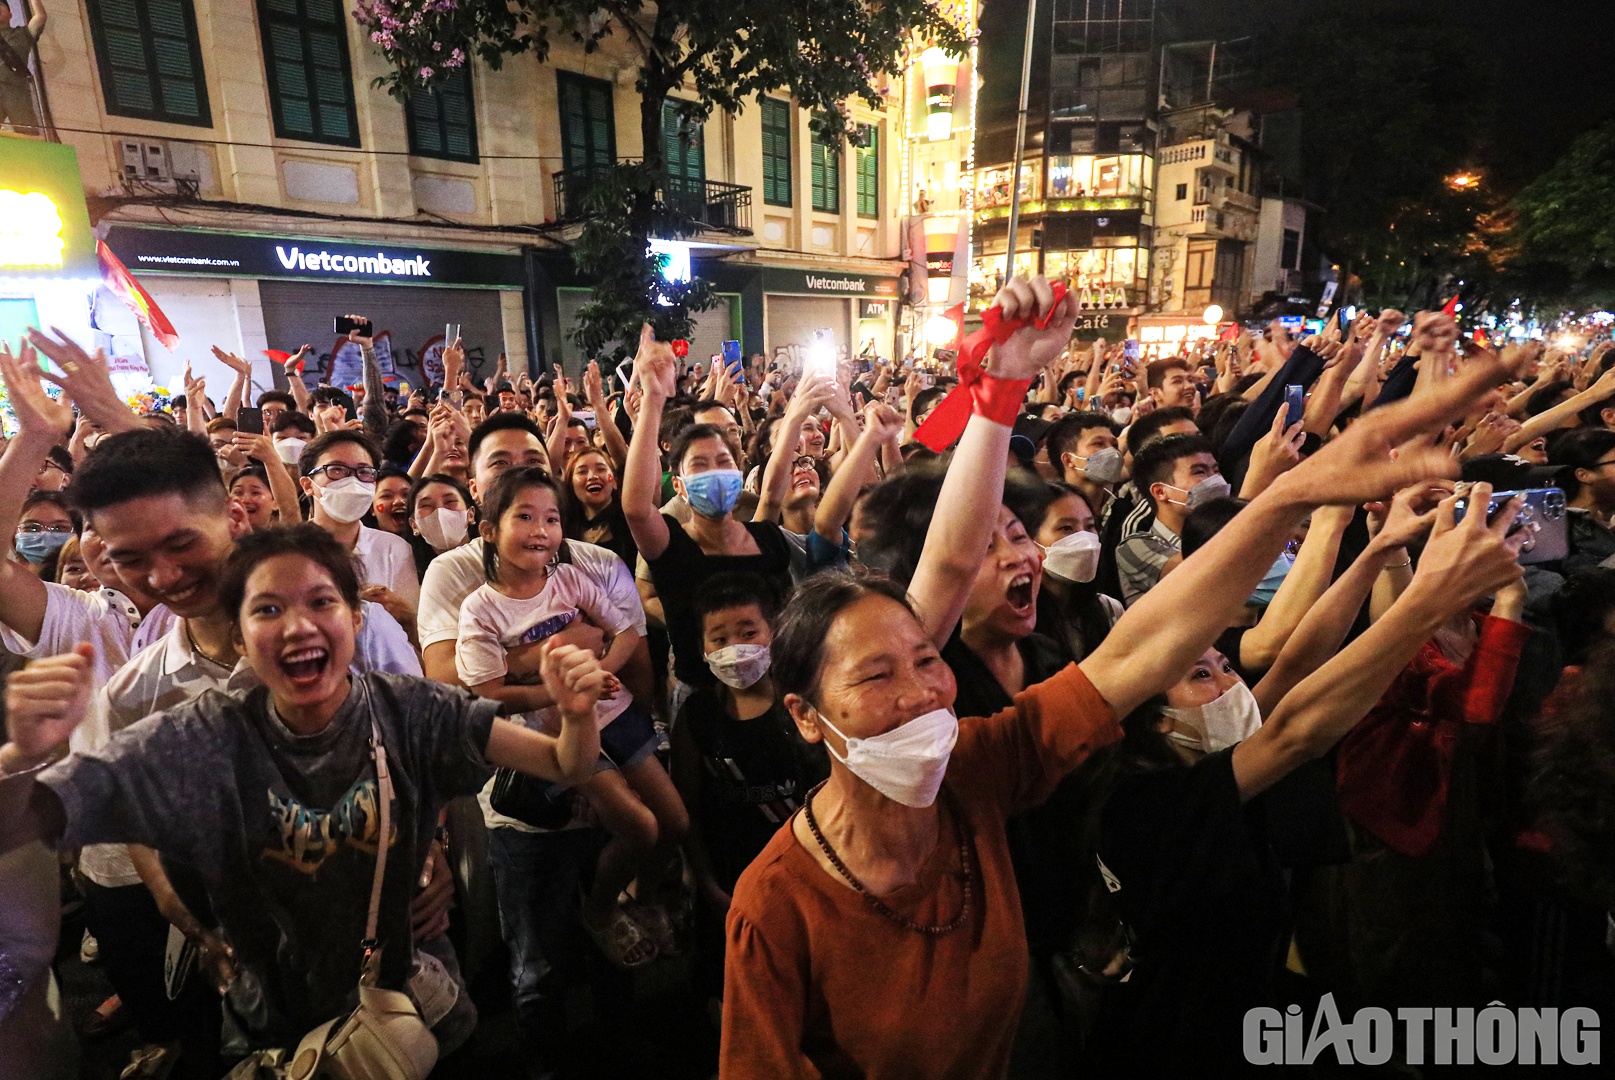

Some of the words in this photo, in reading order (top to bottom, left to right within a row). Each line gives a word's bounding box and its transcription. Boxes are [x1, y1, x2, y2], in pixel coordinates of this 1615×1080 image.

[138, 254, 240, 267] www.vietcombank.com.vn
[275, 245, 432, 276] Vietcombank
[806, 275, 866, 291] Vietcombank
[867, 303, 886, 314] ATM
